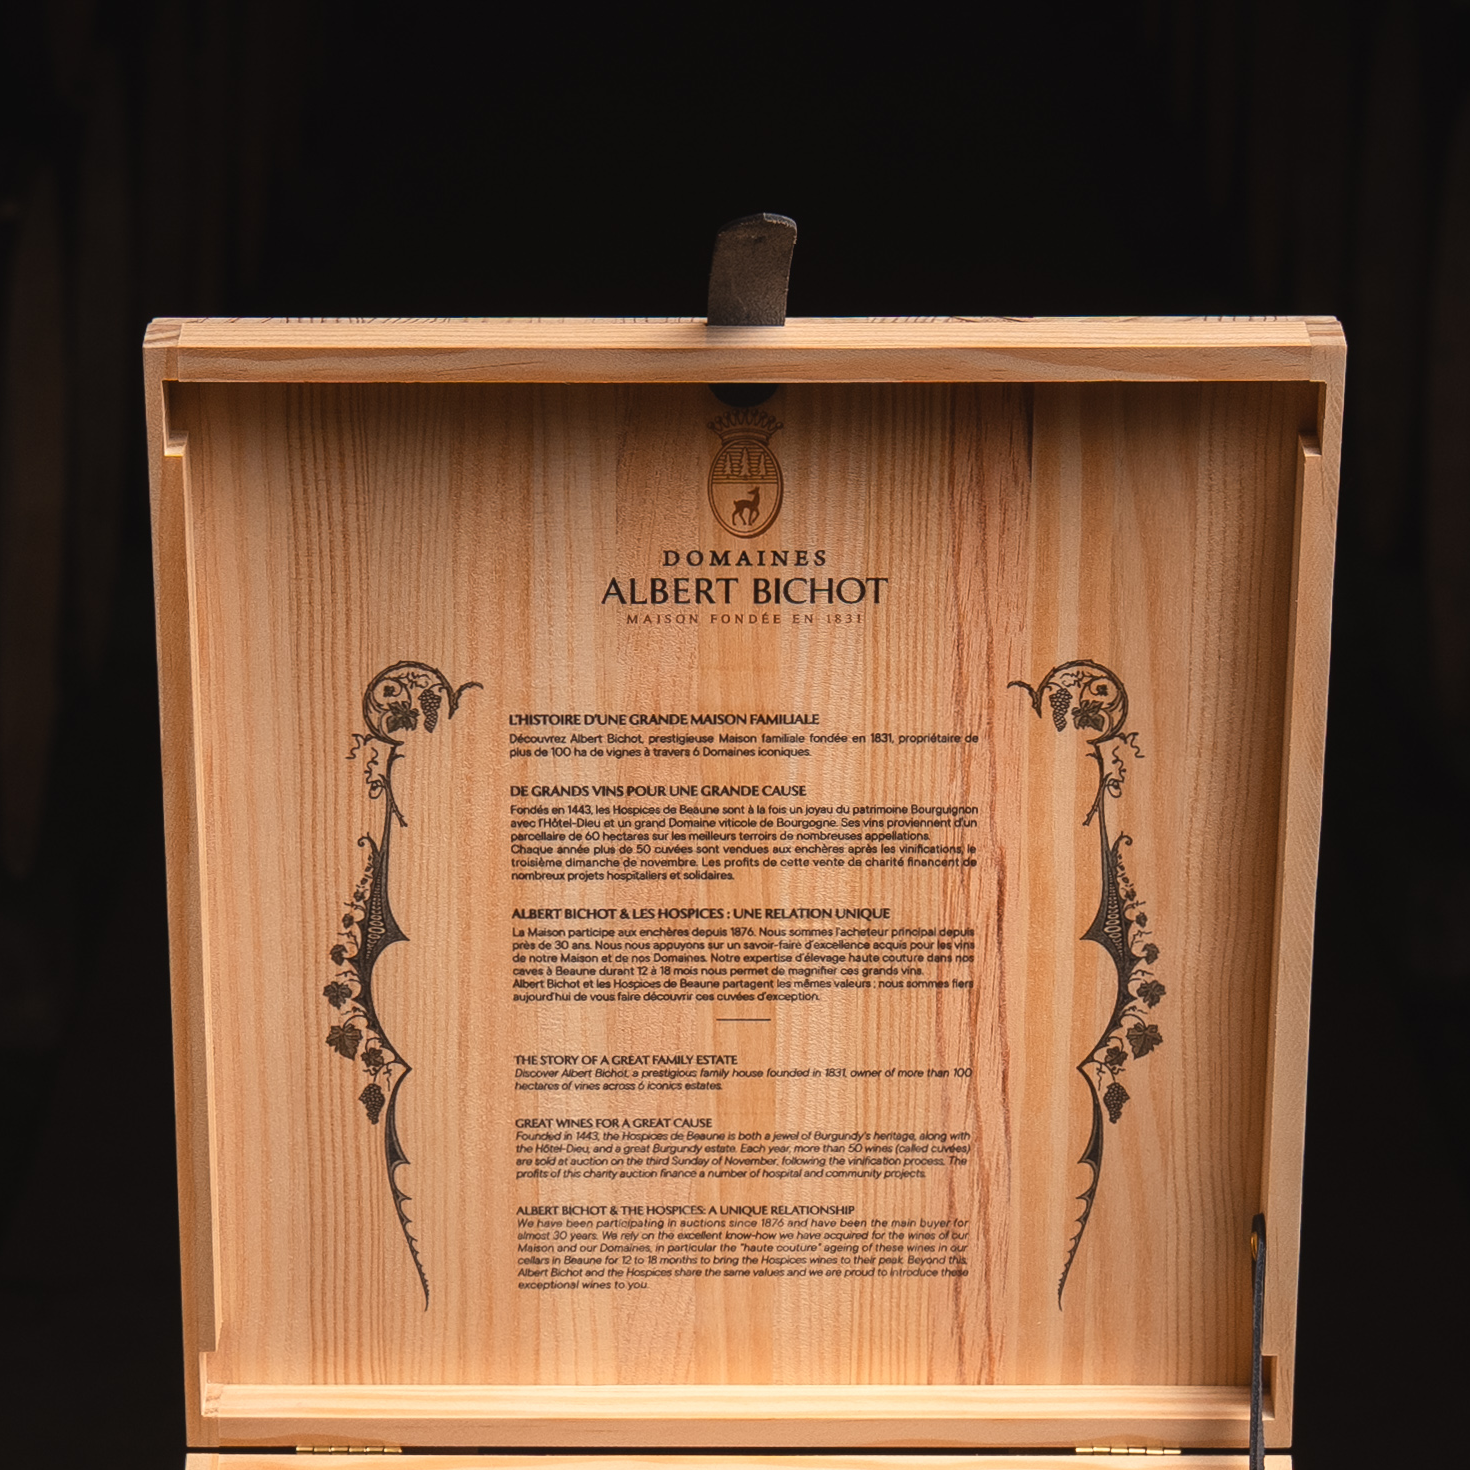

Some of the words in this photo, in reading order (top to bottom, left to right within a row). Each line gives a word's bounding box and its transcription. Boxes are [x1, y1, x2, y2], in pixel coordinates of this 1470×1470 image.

[662, 549, 826, 567] DOMAINES
[601, 577, 739, 605] ALBERT
[753, 577, 888, 605] BICHOT
[627, 612, 699, 624] MAISON
[711, 612, 781, 624] FONDÉE
[792, 614, 814, 625] EN
[827, 614, 862, 625] 1831
[509, 714, 581, 726] L'HISTOIRE
[583, 713, 628, 726] D'UNE
[629, 714, 688, 725] GRANDE
[691, 713, 747, 725] MAISON
[749, 713, 820, 726] FAMILIALE
[509, 733, 567, 744] Découvrez
[570, 734, 603, 743] Albert
[607, 734, 644, 744] Bichot,
[649, 733, 714, 746] prestigieuse
[719, 733, 757, 743] Maison
[761, 733, 805, 743] familiale
[809, 732, 849, 743] fondée
[871, 732, 894, 744] 1831,
[898, 733, 962, 746] propriétaire
[964, 733, 979, 744] de
[510, 786, 529, 797] DE
[531, 785, 589, 797] GRANDS
[591, 785, 624, 797] VINS
[625, 785, 667, 797] POUR
[669, 785, 698, 796] UNE
[701, 785, 759, 796] GRANDE
[761, 784, 807, 797] CAUSE
[511, 871, 565, 881] nombreux
[567, 870, 605, 882] projets
[607, 870, 667, 882] hospitaliers
[669, 868, 681, 880] et
[683, 868, 735, 880] solidaires.
[511, 908, 562, 919] ALBERT
[564, 908, 617, 919] BICHOT
[619, 908, 630, 919] &
[632, 908, 655, 919] LES
[657, 906, 724, 919] HOSPICES
[733, 908, 762, 919] UNE
[765, 908, 833, 920] RELATION
[835, 907, 891, 921] UNIQUE
[515, 1054, 538, 1065] THE
[540, 1055, 579, 1065] STORY
[581, 1055, 598, 1065] OF
[600, 1055, 609, 1065] A
[611, 1054, 650, 1065] GREAT
[652, 1055, 693, 1065] FAMILY
[696, 1055, 738, 1065] ESTATE
[515, 1118, 553, 1128] GREAT
[556, 1118, 593, 1128] WINES
[595, 1118, 619, 1128] FOR
[622, 1118, 631, 1128] A
[632, 1118, 671, 1128] GREAT
[673, 1118, 712, 1128] CAUSE
[516, 1205, 560, 1216] ALBERT
[561, 1205, 608, 1216] BICHOT
[609, 1206, 618, 1216] &
[620, 1206, 643, 1216] THE
[646, 1205, 706, 1215] HOSPICES:
[708, 1206, 717, 1215] A
[719, 1205, 768, 1218] UNIQUE
[770, 1205, 855, 1216] RELATIONSHIP
[518, 1280, 579, 1290] exceptional
[582, 1280, 611, 1289] wines
[615, 1281, 625, 1289] to
